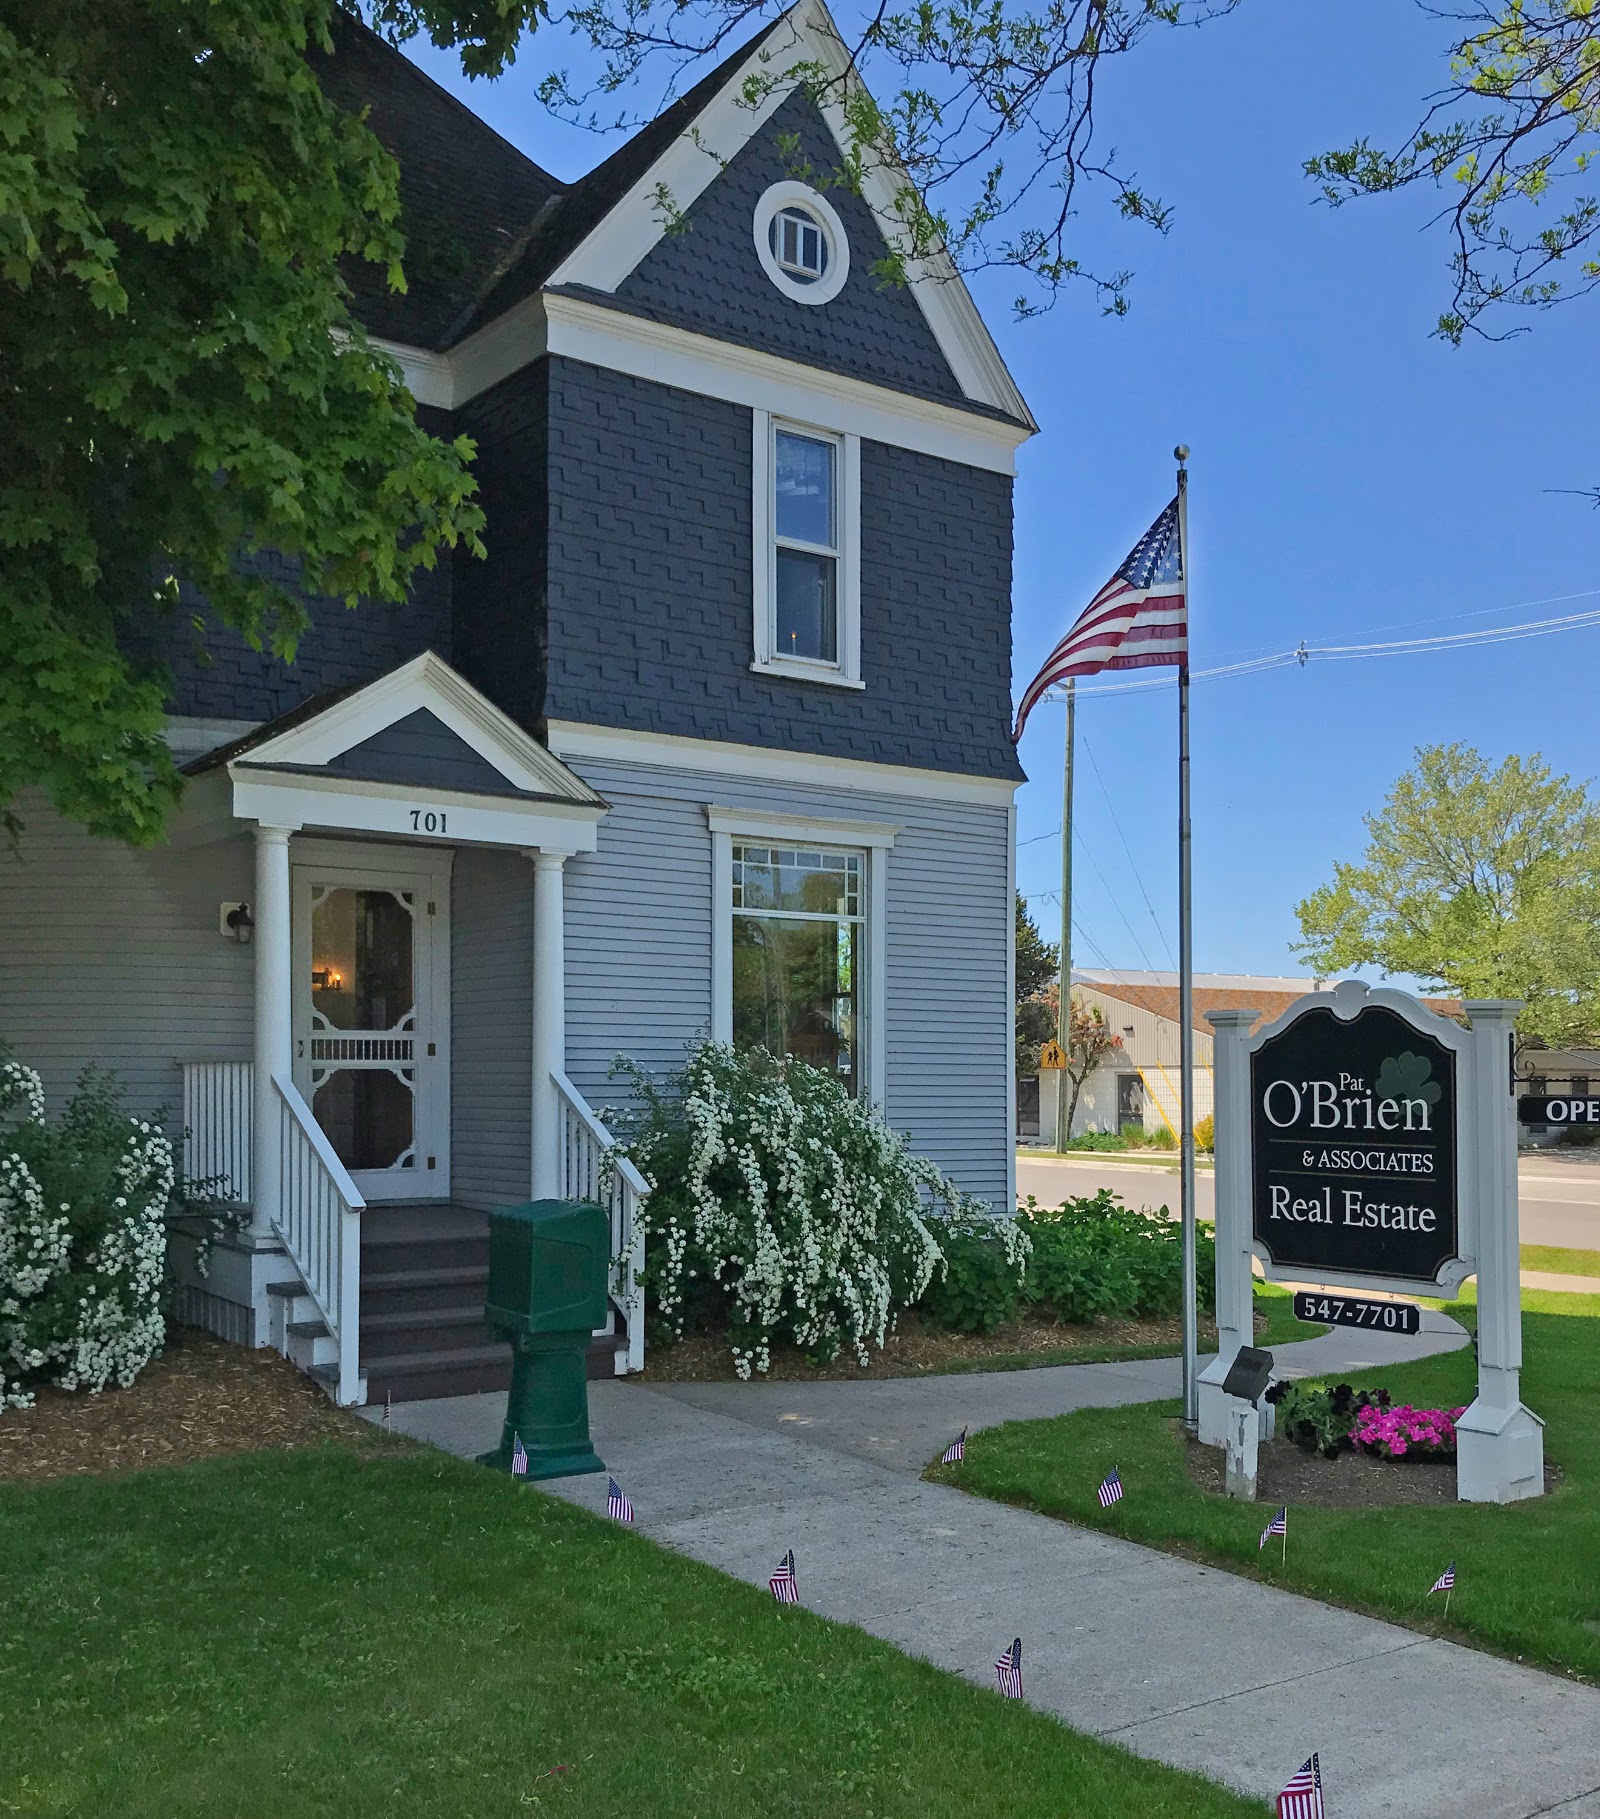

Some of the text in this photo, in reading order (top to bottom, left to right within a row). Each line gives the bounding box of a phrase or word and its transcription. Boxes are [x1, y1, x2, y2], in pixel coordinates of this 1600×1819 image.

[410, 810, 447, 833] 701
[1339, 1073, 1364, 1092] Pat
[1263, 1080, 1432, 1131] O'Brien
[1302, 1150, 1434, 1173] & ASSOCIATES
[1269, 1185, 1436, 1232] Real Estate
[1304, 1298, 1409, 1329] 547-7701
